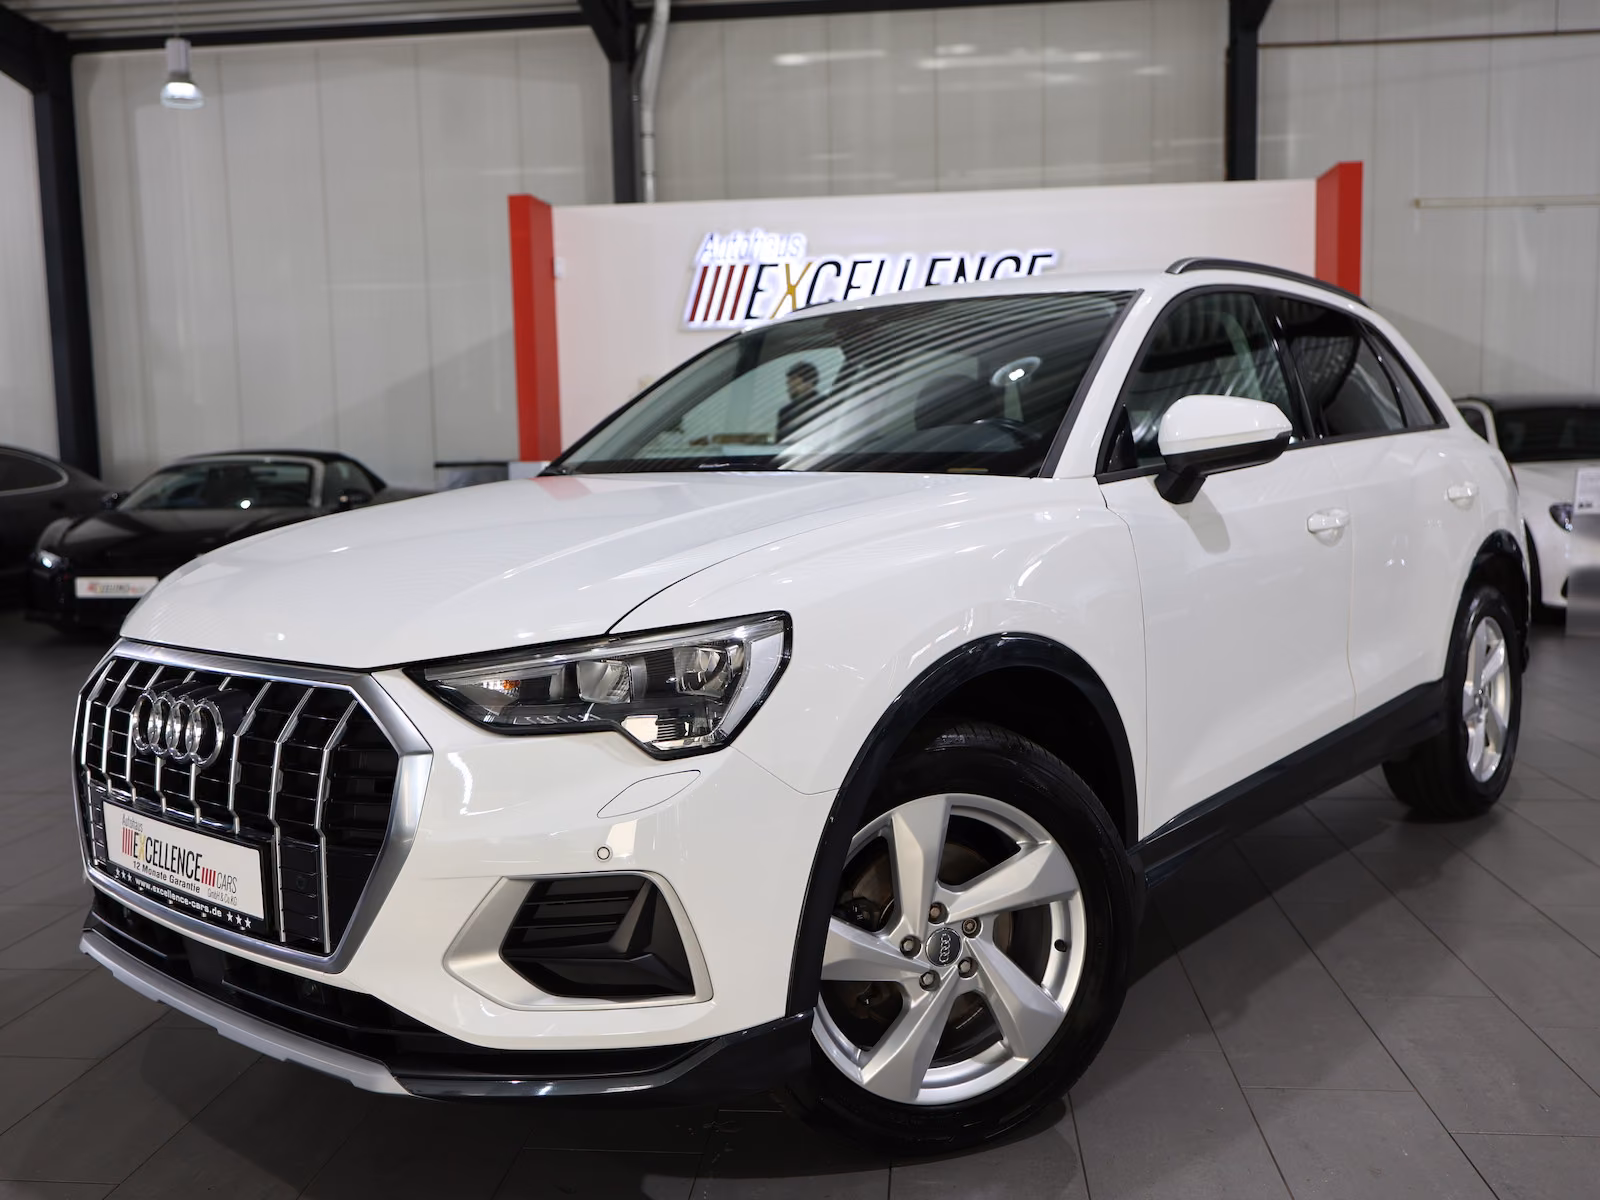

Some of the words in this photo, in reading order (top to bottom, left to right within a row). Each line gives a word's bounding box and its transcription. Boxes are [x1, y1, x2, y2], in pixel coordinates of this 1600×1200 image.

[700, 231, 803, 260] Autohaus
[132, 831, 203, 882] EXCELLENCE
[216, 872, 238, 894] CARS
[132, 860, 141, 870] 12
[142, 864, 167, 881] Monate
[169, 874, 200, 893] Garantie
[134, 877, 223, 918] www.excellence-cars.de
